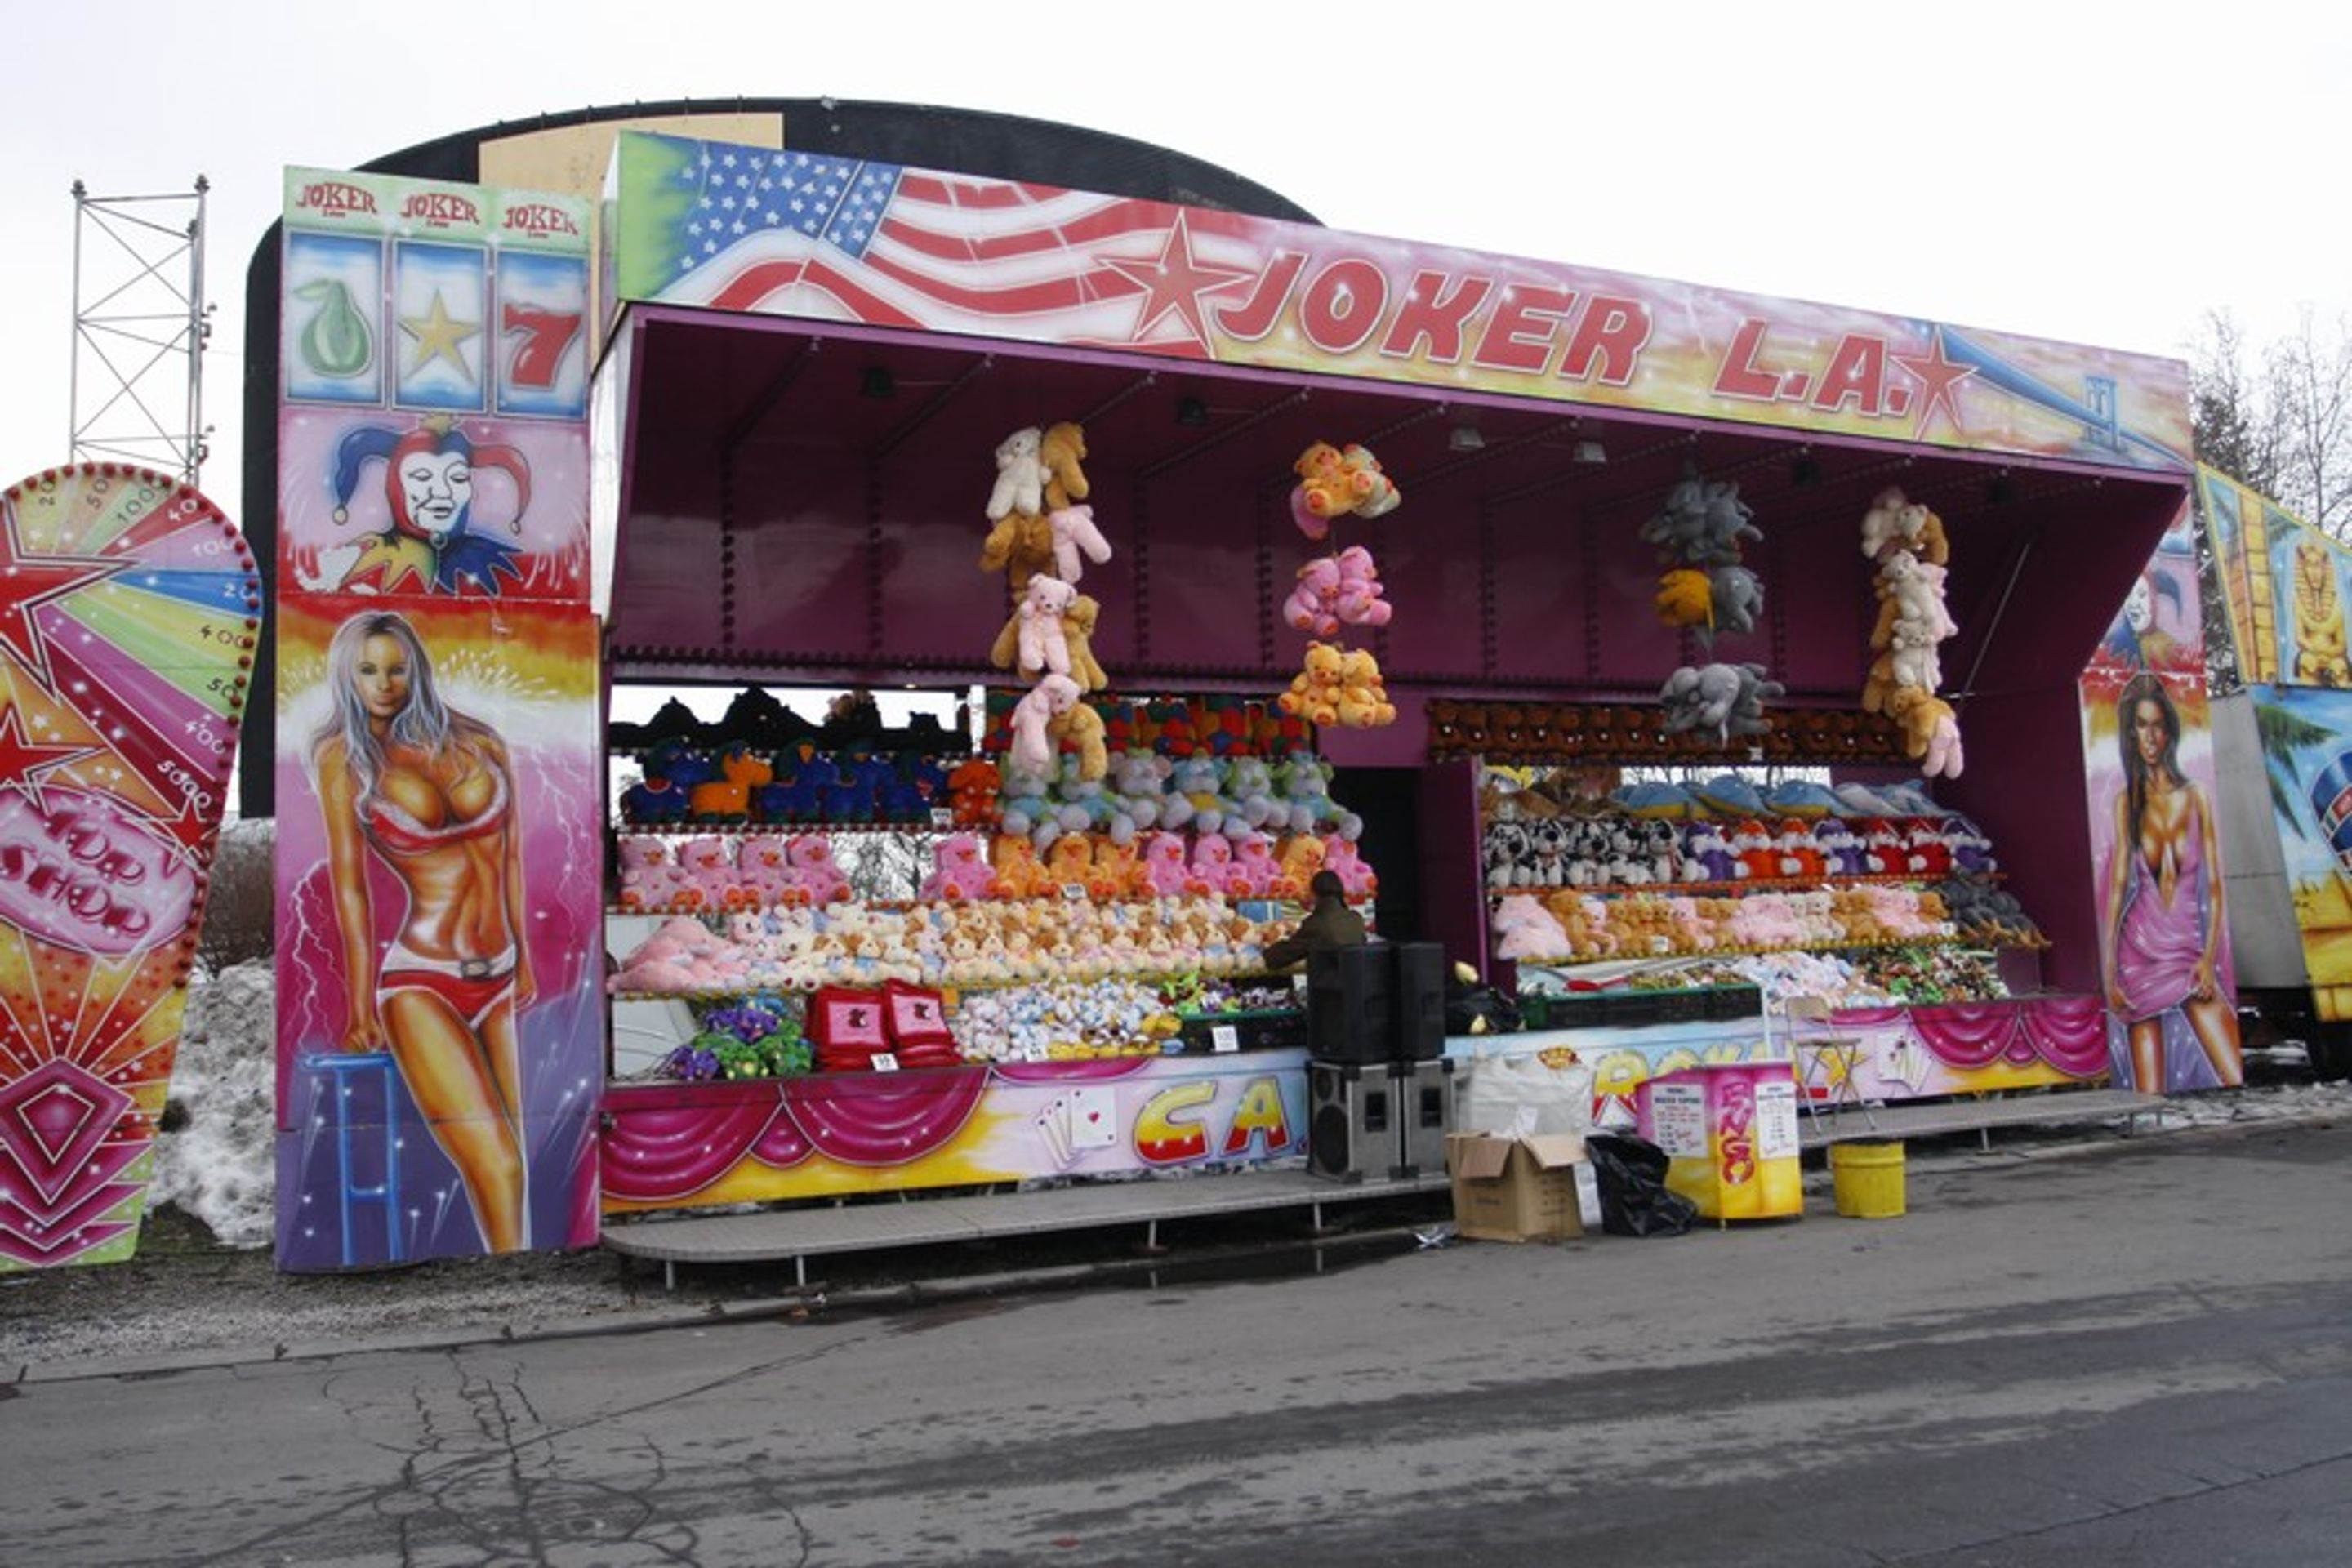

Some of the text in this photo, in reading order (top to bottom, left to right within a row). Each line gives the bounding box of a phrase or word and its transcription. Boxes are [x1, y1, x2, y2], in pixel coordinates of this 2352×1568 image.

[296, 183, 377, 214] JOKER
[400, 193, 480, 225] JOKER
[502, 204, 579, 235] JOKER
[502, 303, 582, 388] 7
[1214, 250, 1913, 417] JOKER L.A.
[86, 478, 109, 509] 50
